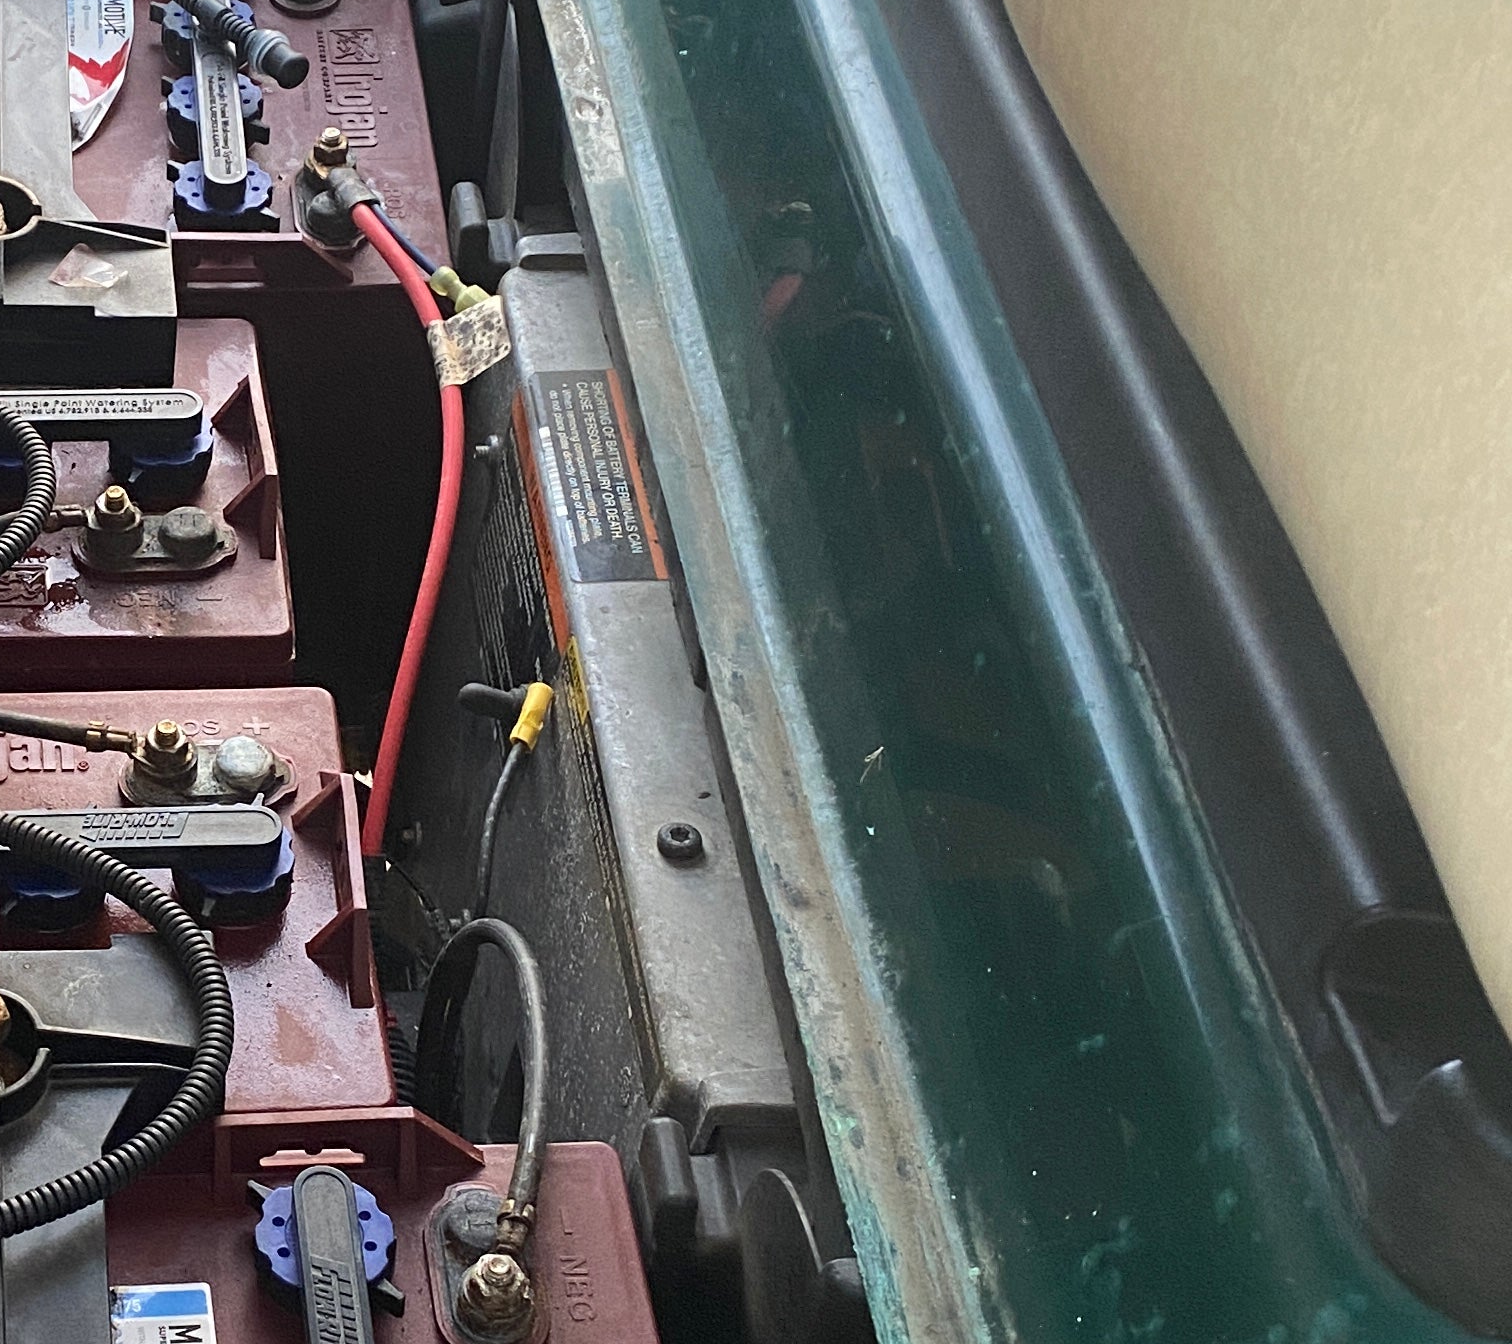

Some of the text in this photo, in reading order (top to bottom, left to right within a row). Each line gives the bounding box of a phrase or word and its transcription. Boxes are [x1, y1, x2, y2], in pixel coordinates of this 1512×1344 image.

[325, 68, 388, 147] Trojan
[15, 400, 49, 408] Single
[54, 399, 83, 407] Point
[85, 399, 138, 408] Watering
[142, 398, 184, 407] System
[576, 381, 593, 411] CAUSE
[584, 411, 604, 458] PERSONAL
[595, 459, 613, 492] INJURY
[606, 440, 625, 479] BATTERY
[616, 481, 638, 532] TERMINALS
[628, 533, 643, 554] CAN
[559, 1257, 598, 1322] NEG
